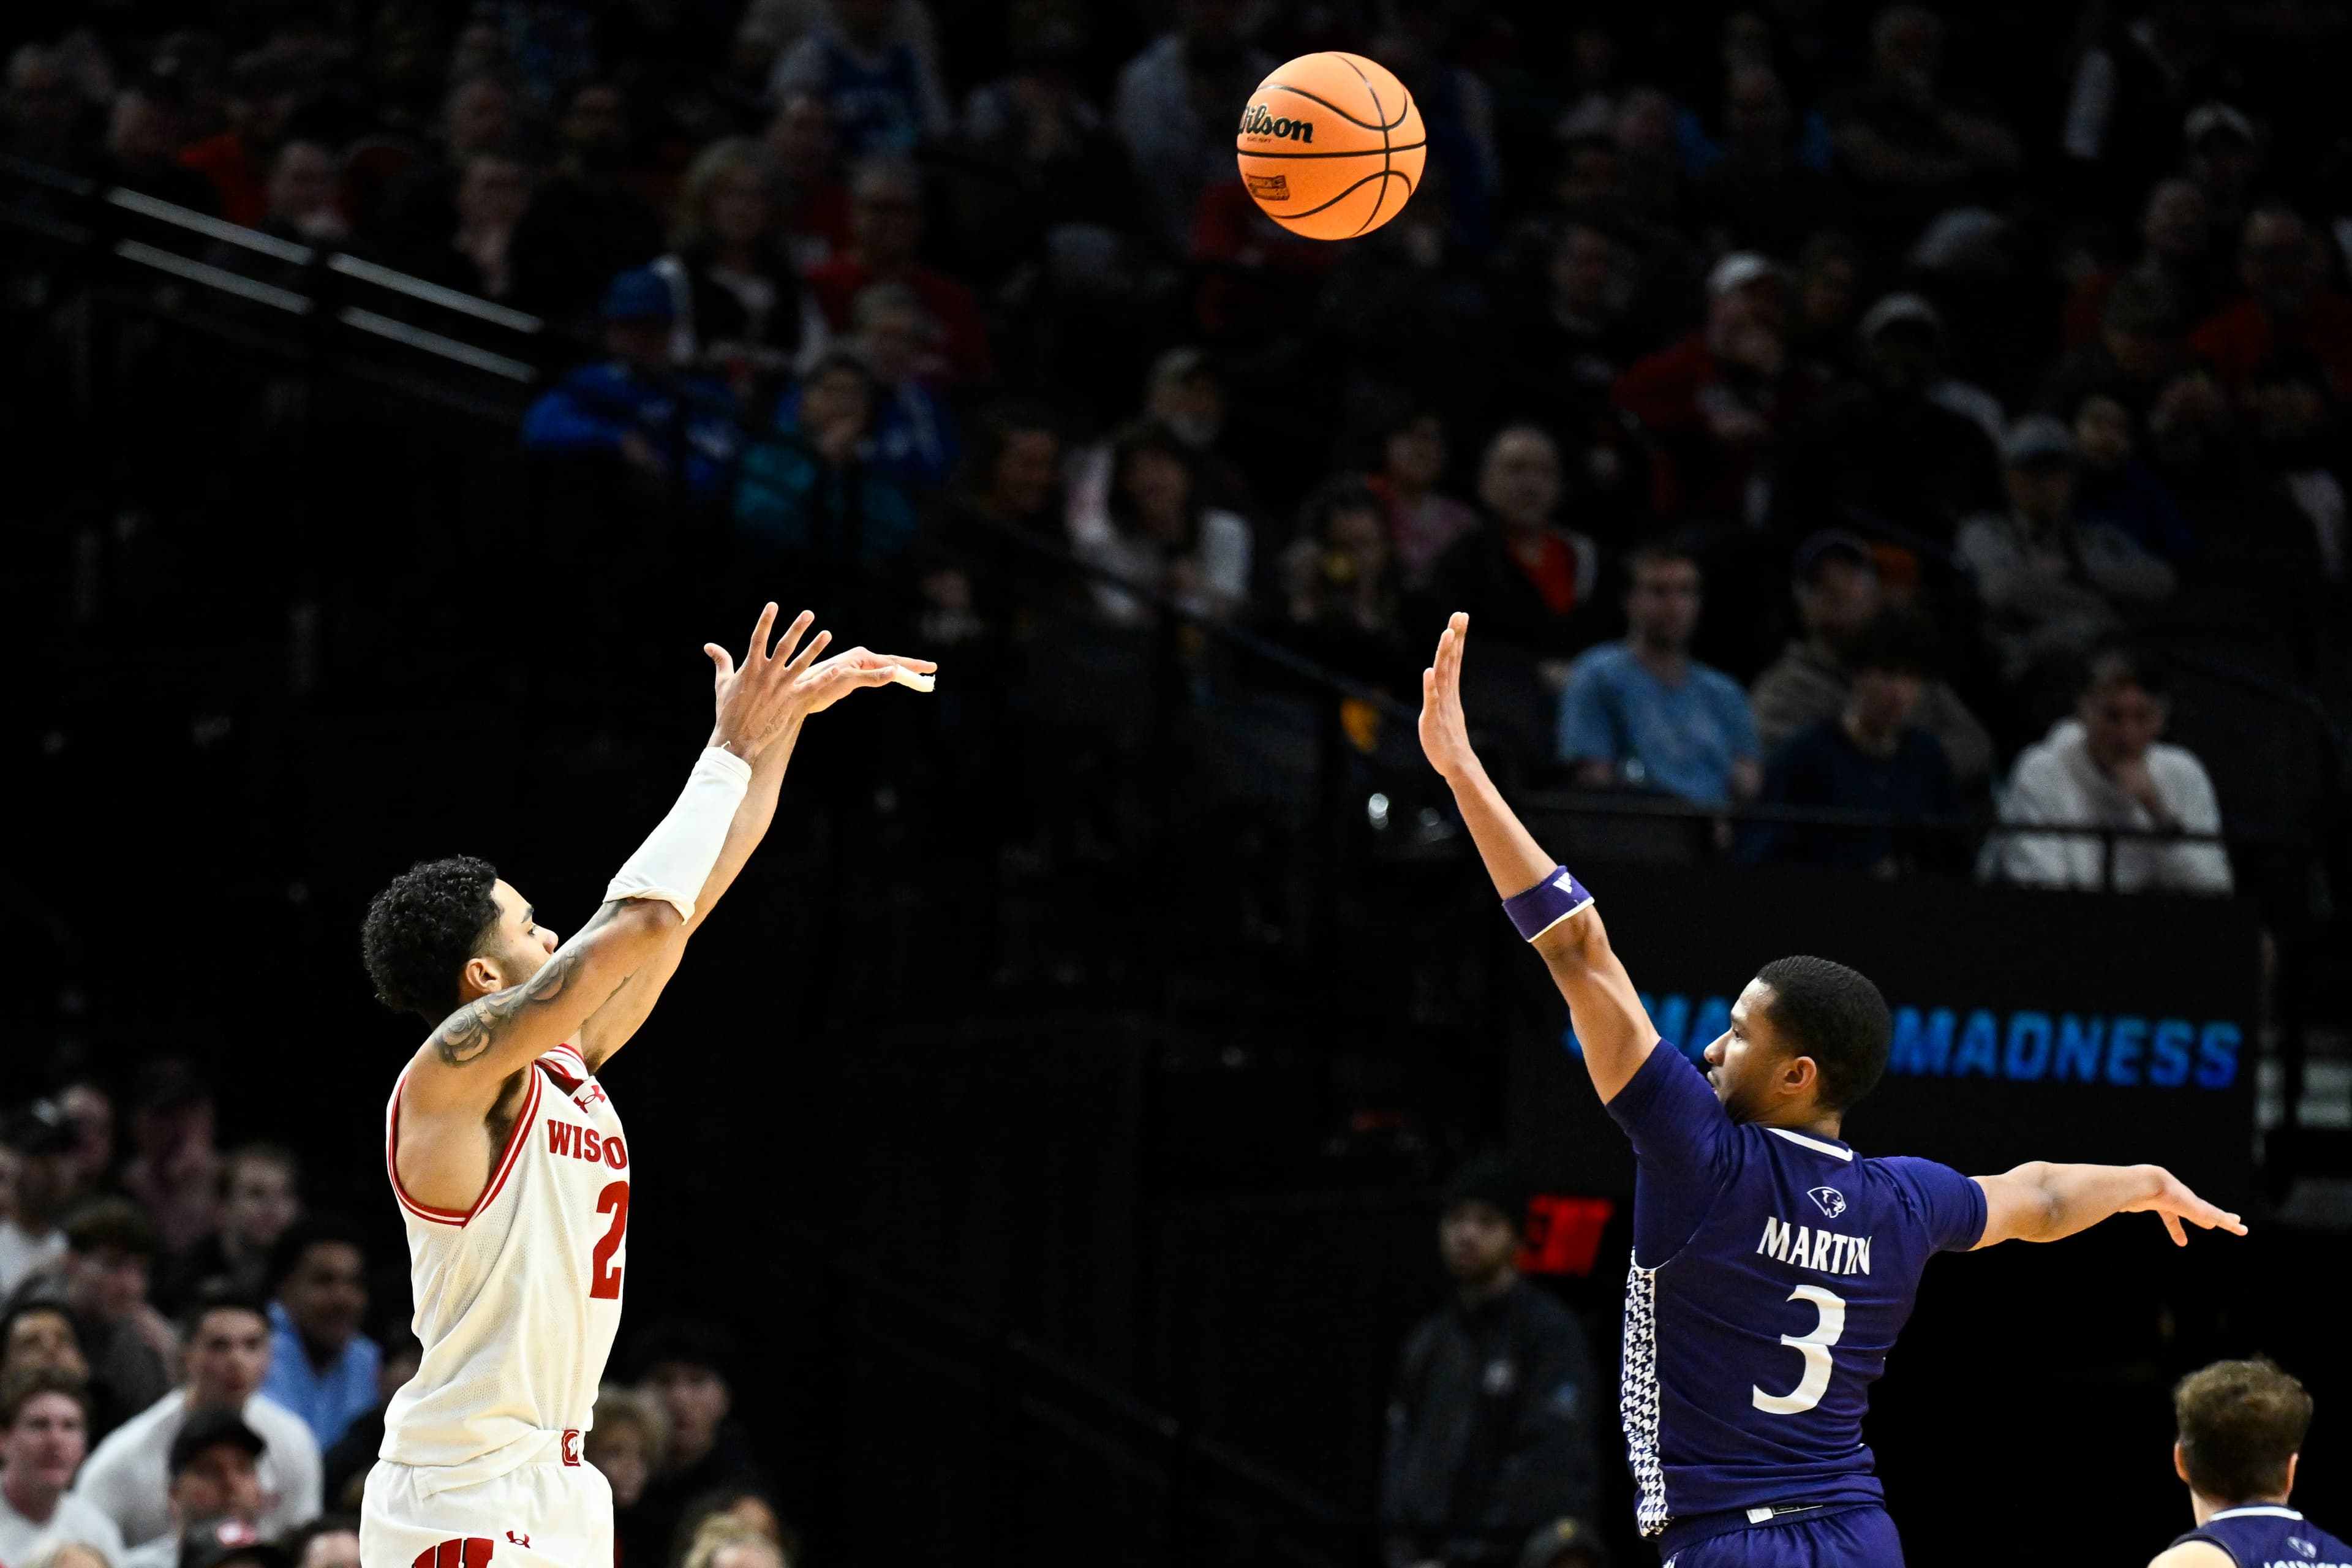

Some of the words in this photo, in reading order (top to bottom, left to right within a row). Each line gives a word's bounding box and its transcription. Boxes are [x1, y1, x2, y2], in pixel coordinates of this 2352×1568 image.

[1888, 1003, 2244, 1093] MADNESS
[589, 1180, 630, 1299] 2
[1756, 1216, 1872, 1276] MARTIN
[1752, 1284, 1847, 1415] 3
